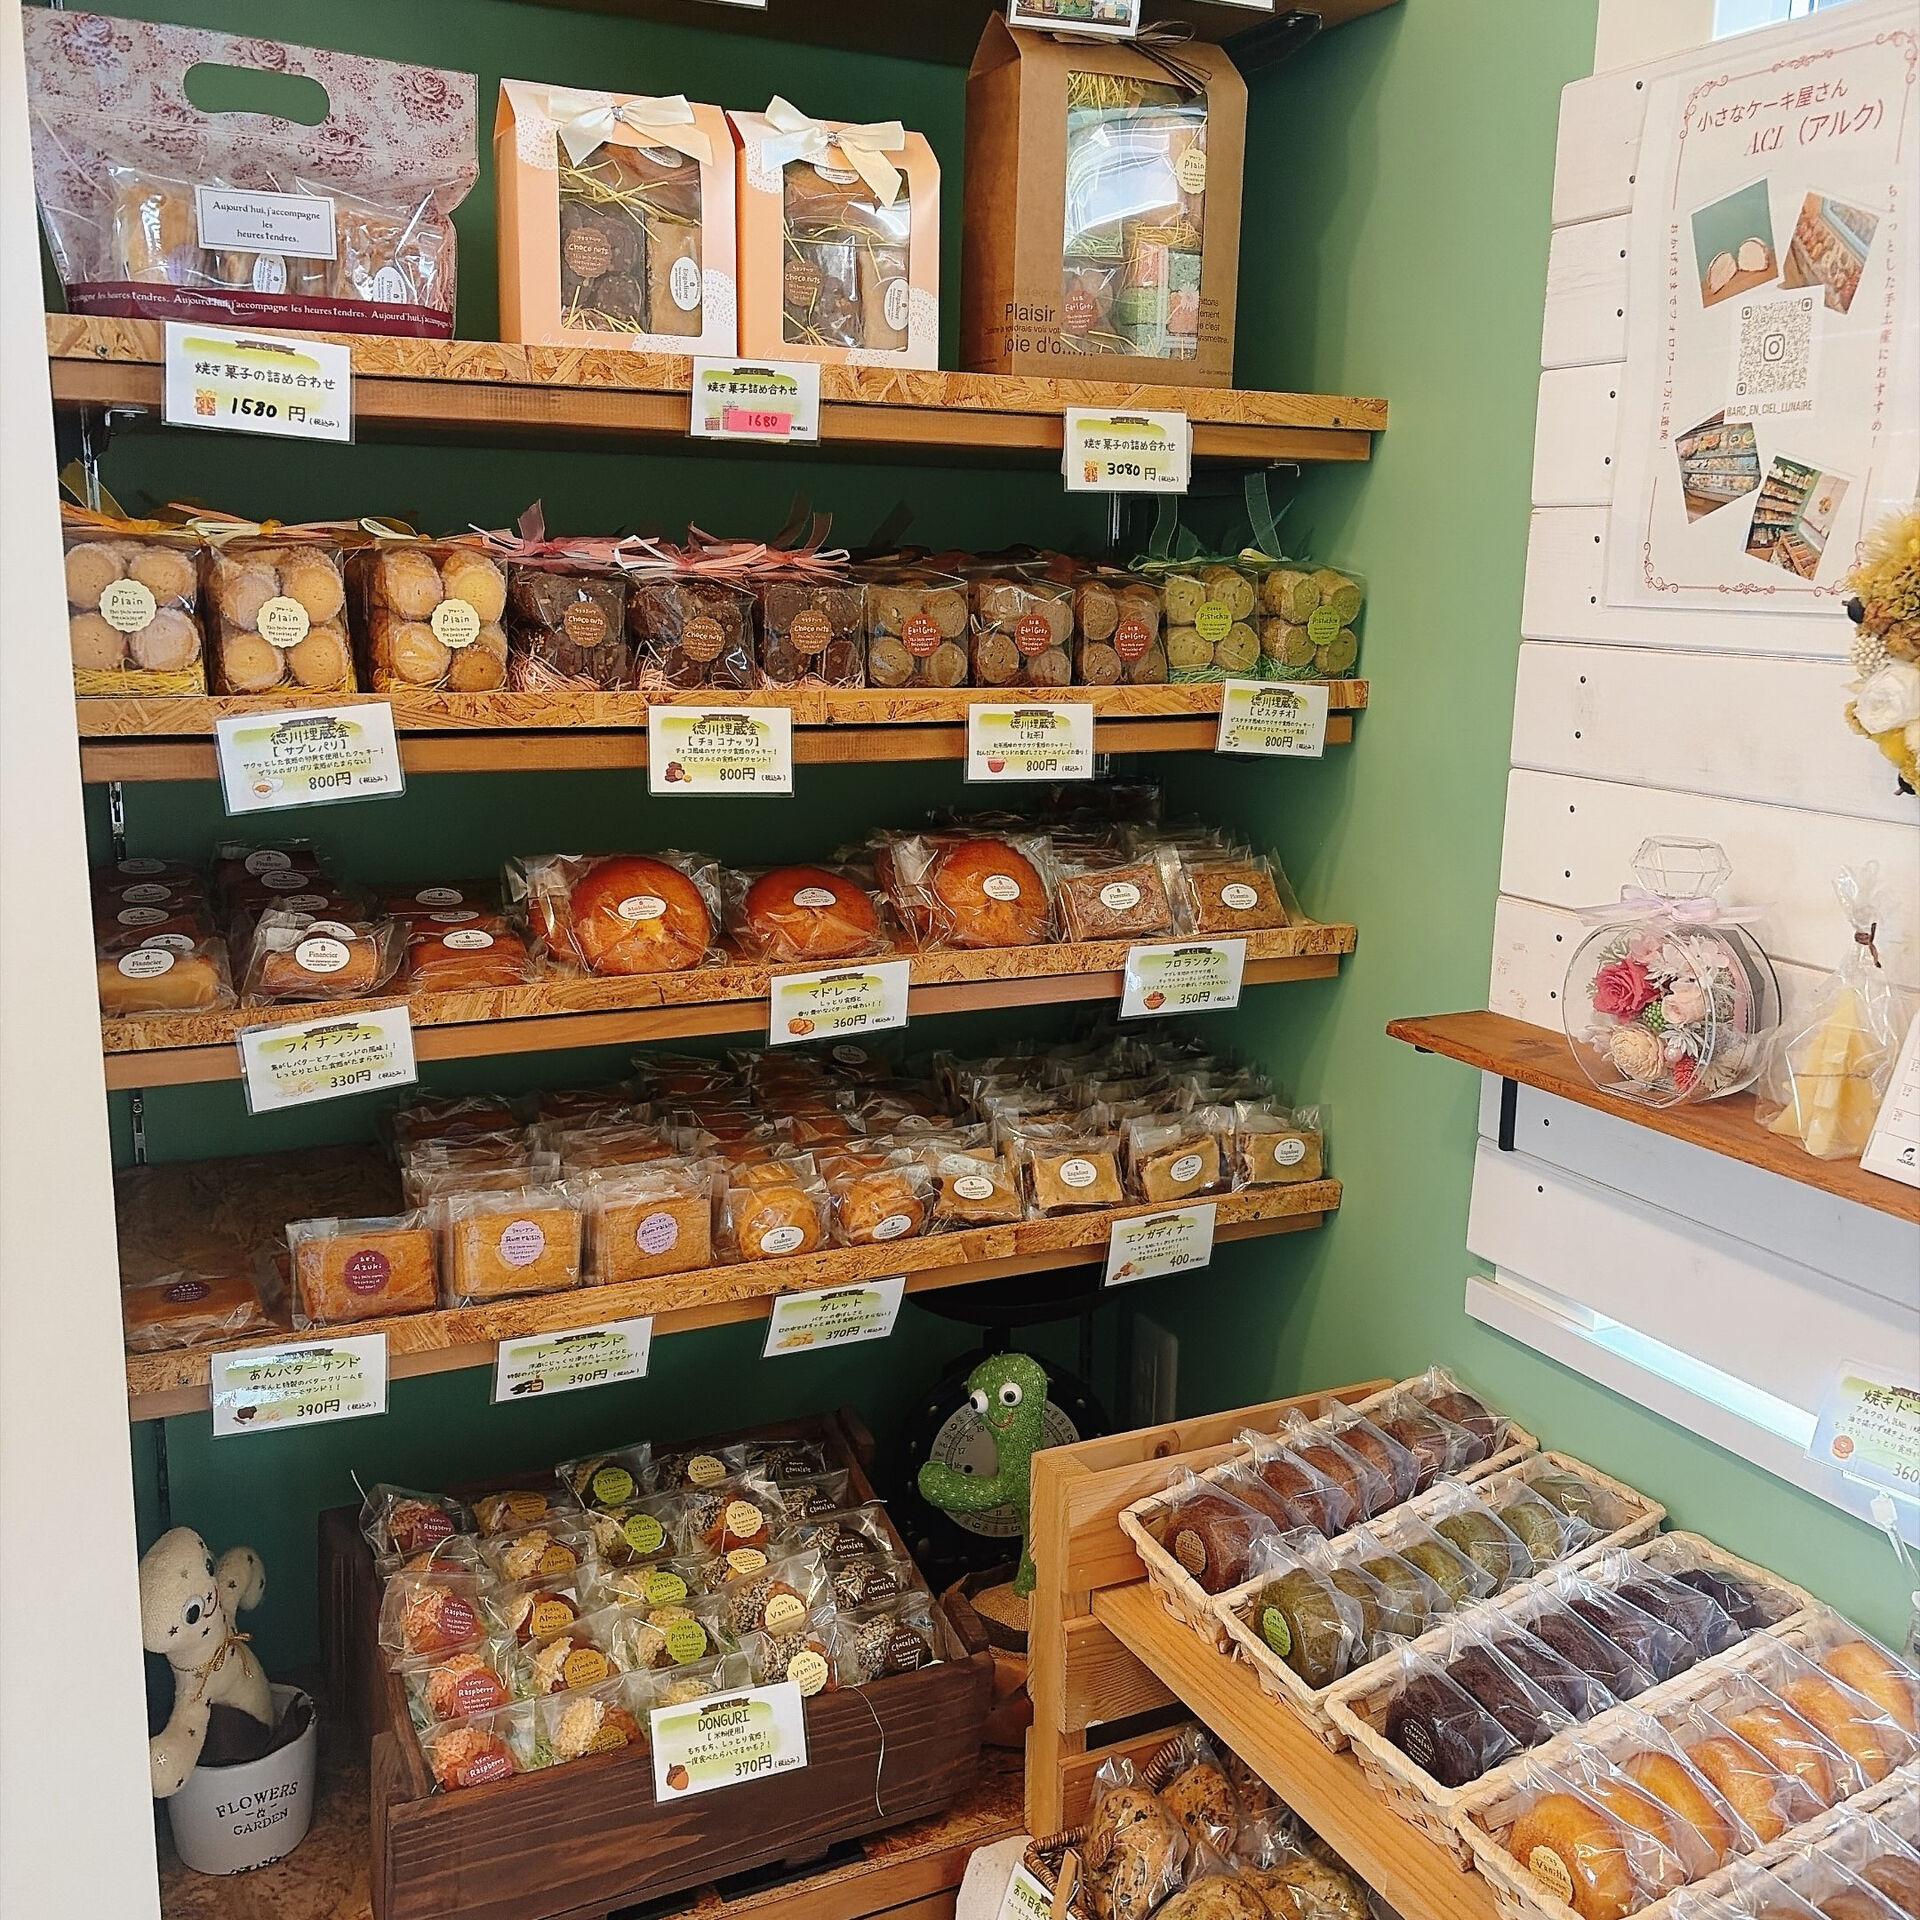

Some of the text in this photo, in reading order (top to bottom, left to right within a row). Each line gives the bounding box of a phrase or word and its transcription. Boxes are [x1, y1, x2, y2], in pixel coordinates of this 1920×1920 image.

[1697, 77, 1848, 132] 小さなケーキ屋さん
[262, 219, 273, 230] les
[236, 230, 300, 244] heures tendres.
[290, 303, 302, 313] les
[304, 305, 333, 315] heures
[333, 306, 368, 319] tendres.
[1004, 303, 1056, 322] Plaisir
[1003, 334, 1030, 358] joie
[194, 361, 336, 390] 焼き菓子の詰め合わせ
[707, 381, 798, 396] 焼き菓子詰め合わせ
[231, 397, 278, 420] 1580
[288, 404, 306, 423] 円
[748, 414, 778, 428] 1680
[1083, 437, 1176, 452] 焼き菓子の詰め合わせ
[1107, 462, 1141, 476] 3080
[1144, 467, 1157, 481] 円
[111, 595, 143, 607] Plain
[269, 611, 299, 623] Plain
[442, 614, 470, 624] Plain
[568, 615, 589, 624] Choco
[686, 632, 708, 641] Choco
[794, 625, 815, 633] Choco
[907, 626, 923, 635] Earl
[1020, 626, 1034, 635] Earl
[1120, 632, 1134, 640] Earl
[1251, 694, 1301, 710] 徳川埋蔵金
[1249, 706, 1297, 719] 【ピスタチオ】
[691, 722, 760, 737] 徳川埋蔵金
[1010, 718, 1058, 730] 徳川埋蔵金
[270, 723, 350, 746] 徳川埋蔵金
[688, 736, 760, 747] 【チョコナッツ】
[1020, 731, 1044, 740] 【紅茶】
[1265, 735, 1293, 749] 800円
[271, 739, 347, 758] 【サブレパリ】
[1026, 758, 1058, 772] 800円
[308, 770, 352, 791] 800円
[719, 767, 756, 781] 800円
[308, 950, 339, 959] Financier
[1164, 956, 1221, 970] フロランタン
[809, 982, 870, 999] マドレーヌ
[1178, 990, 1211, 1005] 350円
[833, 1013, 868, 1029] 360円
[285, 1031, 372, 1054] フィナンシェ
[329, 1069, 372, 1089] 330円
[1125, 1223, 1195, 1245] エンガディナー
[353, 1263, 382, 1271] Azuki
[1169, 1253, 1190, 1267] 400
[819, 1298, 862, 1313] ガレット
[825, 1325, 860, 1341] 370円
[537, 1336, 625, 1360] レーズンサンド
[249, 1357, 362, 1382] あんバターサンド
[568, 1369, 608, 1385] 390円
[296, 1399, 340, 1417] 390円
[1892, 1461, 1920, 1483] 360
[730, 1507, 756, 1520] Vanilla
[809, 1502, 837, 1514] Chocolate
[423, 1522, 452, 1533] Raspberry
[836, 1540, 865, 1552] Chocolate
[867, 1580, 896, 1594] Chocolate
[444, 1606, 474, 1619] Raspberry
[538, 1612, 567, 1623] Almond
[770, 1605, 799, 1620] Vanilla
[891, 1635, 922, 1652] Chocolate
[571, 1658, 600, 1674] Almond
[792, 1661, 822, 1678] Vanilla
[458, 1685, 494, 1698] Raspberry
[697, 1709, 751, 1733] DONGURI
[469, 1757, 505, 1778] Raspberry
[734, 1754, 772, 1777] 370円
[215, 1781, 299, 1819] FLOWERS
[233, 1807, 289, 1836] GARDEN
[1535, 1858, 1567, 1883] Vanilla
